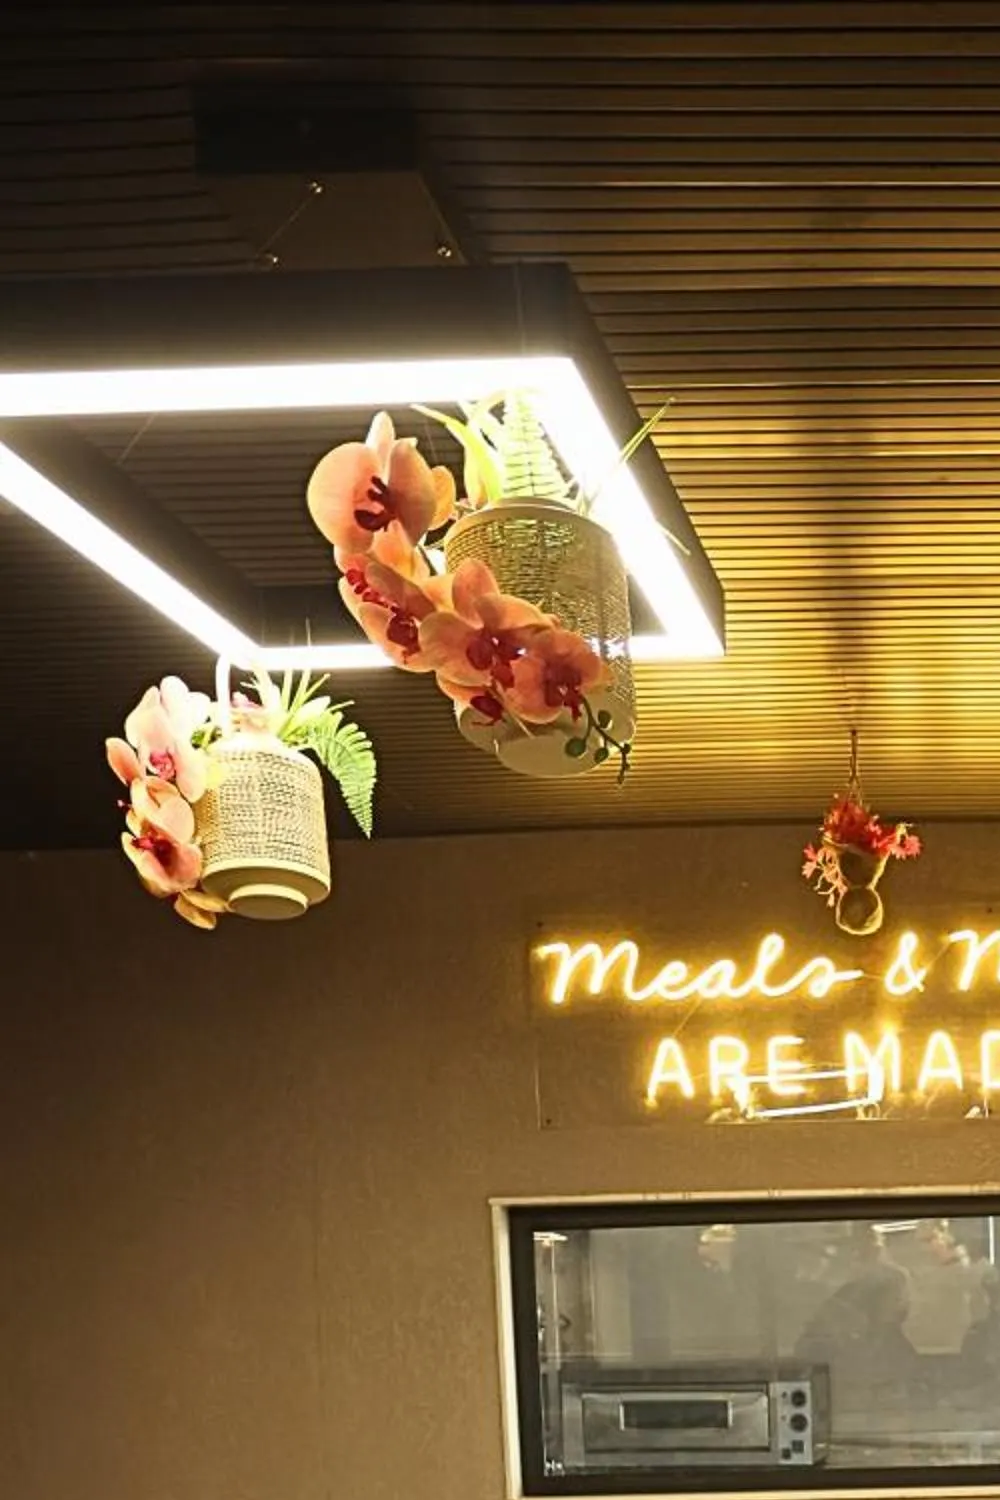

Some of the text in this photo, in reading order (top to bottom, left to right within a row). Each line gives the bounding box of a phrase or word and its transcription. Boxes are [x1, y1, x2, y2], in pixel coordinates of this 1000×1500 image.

[536, 932, 864, 1005] Meals
[884, 931, 928, 994] &
[645, 1036, 806, 1104] ARE
